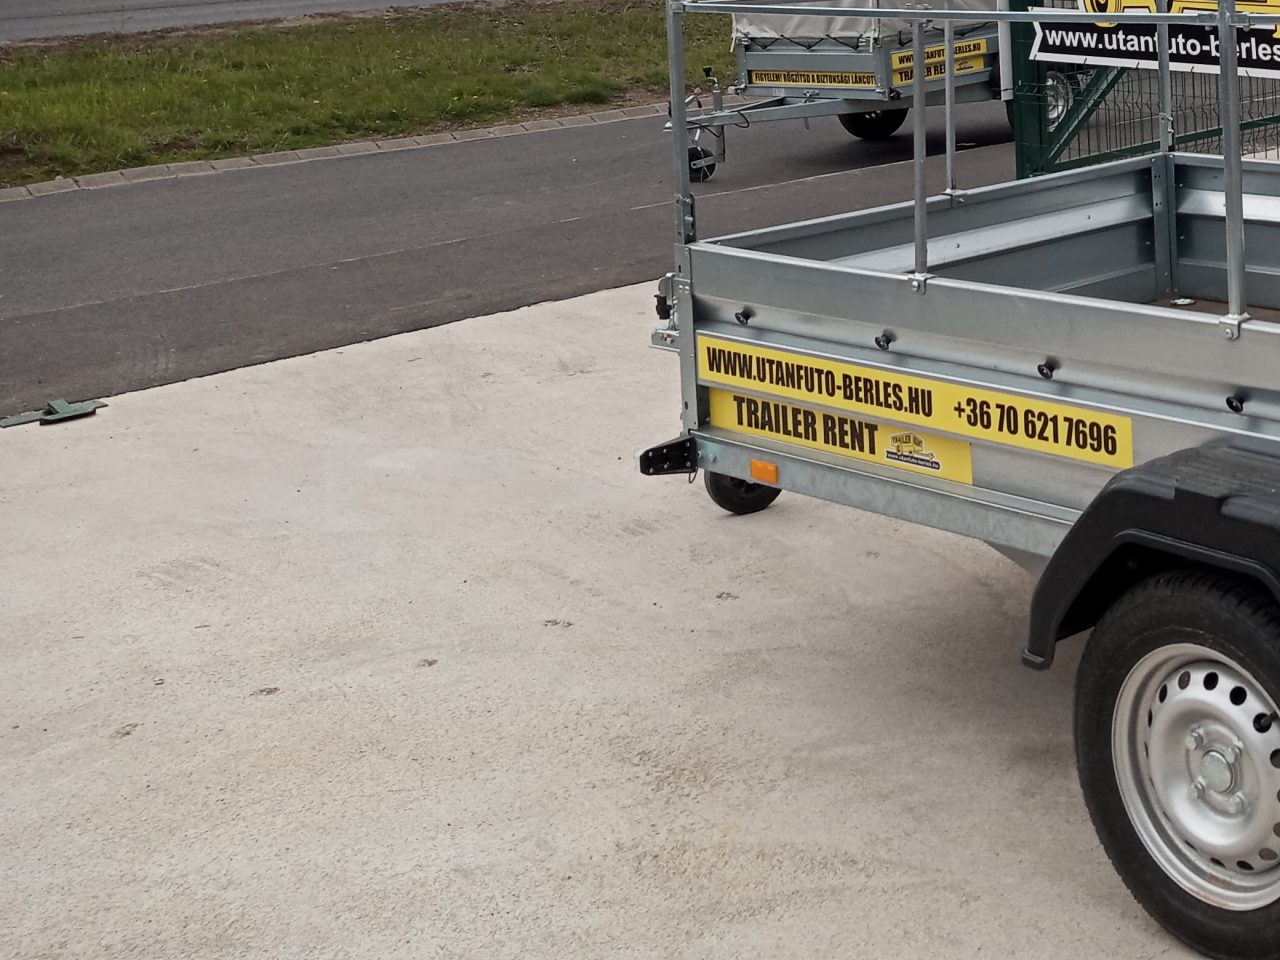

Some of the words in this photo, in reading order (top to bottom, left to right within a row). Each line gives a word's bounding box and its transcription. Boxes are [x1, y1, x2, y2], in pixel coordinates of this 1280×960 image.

[706, 346, 933, 418] WWW.UTANFUTO-BERLES.HU
[953, 397, 991, 428] +36
[995, 405, 1018, 436] 70
[1023, 410, 1060, 444] 621
[1064, 417, 1117, 456] 7696
[733, 395, 818, 441] TRAILER
[823, 416, 878, 456] RENT
